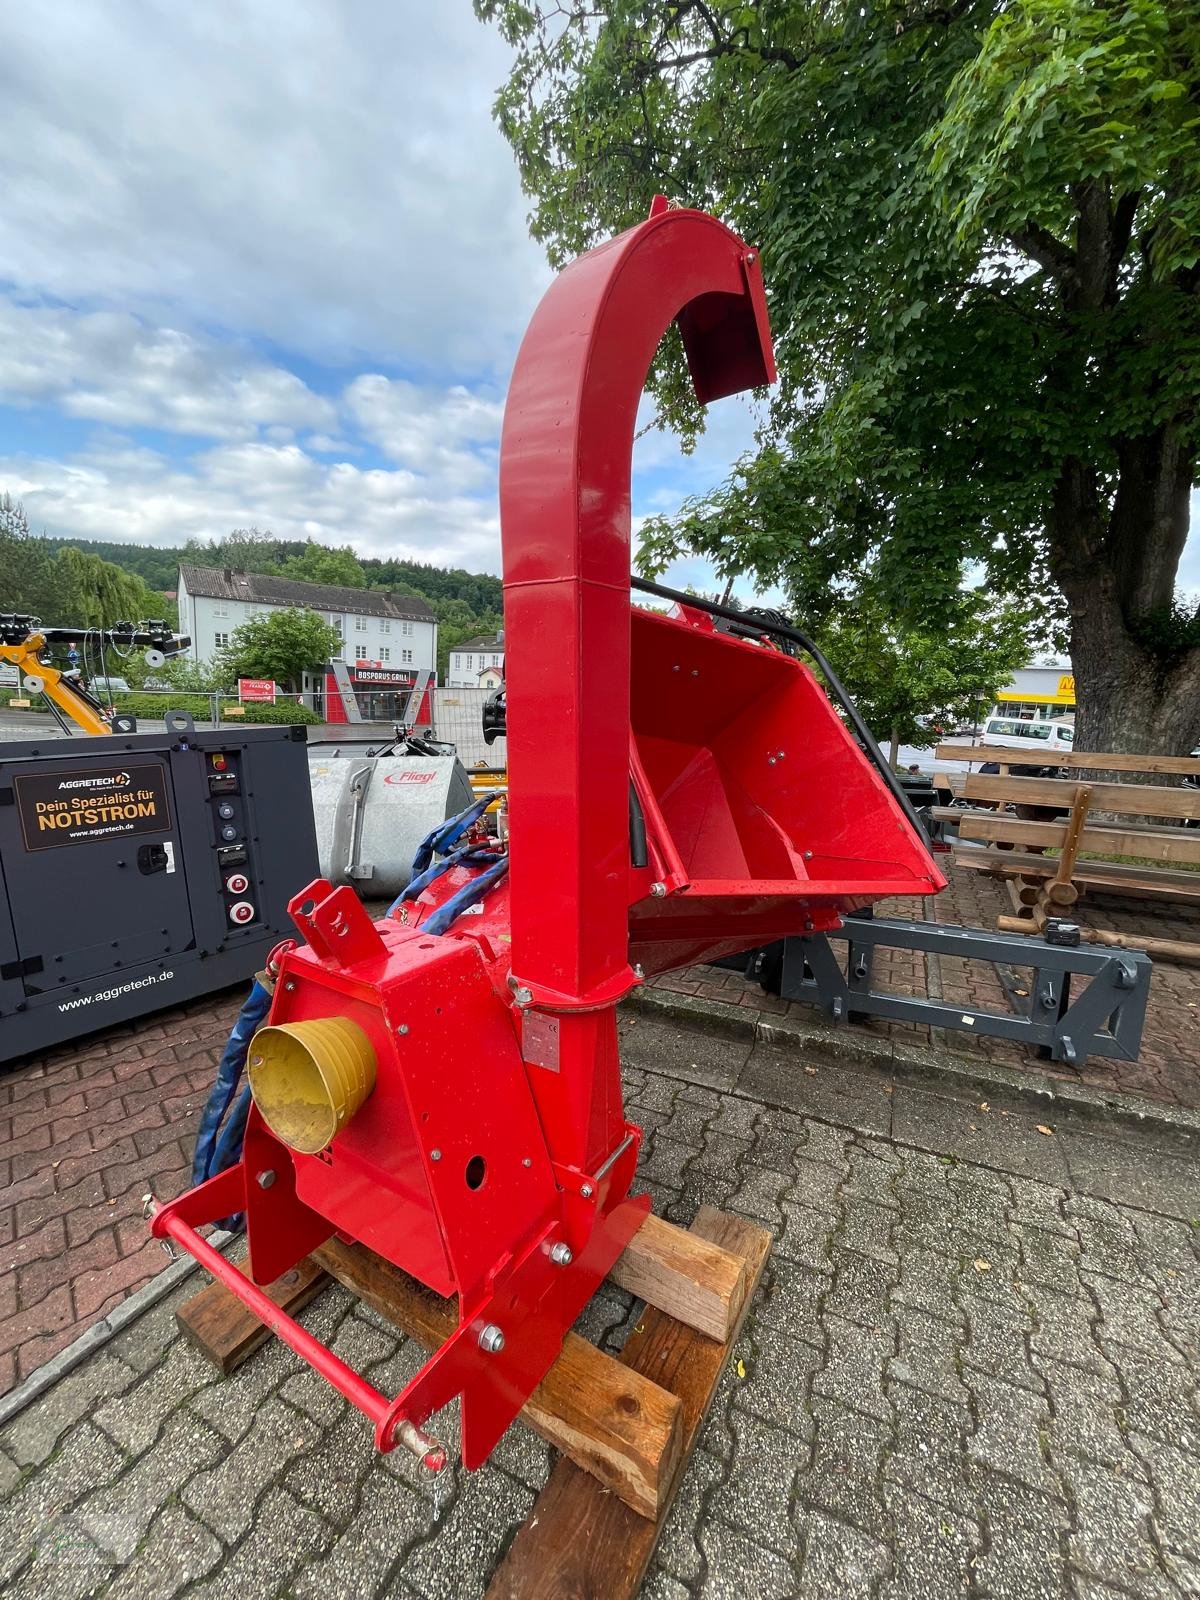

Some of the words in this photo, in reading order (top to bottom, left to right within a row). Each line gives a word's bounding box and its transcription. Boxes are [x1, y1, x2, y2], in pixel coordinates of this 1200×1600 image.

[358, 671, 391, 681] BOSPORUS
[391, 673, 408, 682] GRILL
[58, 777, 115, 790] AGGRETECH
[400, 771, 437, 784] Fliegl
[35, 800, 68, 813] Dein
[71, 791, 135, 810] Spezialist
[137, 790, 154, 801] für
[38, 801, 157, 831] NOTSTROM
[69, 823, 135, 838] www.aggretech.de
[58, 970, 174, 1012] www.aggretech.de
